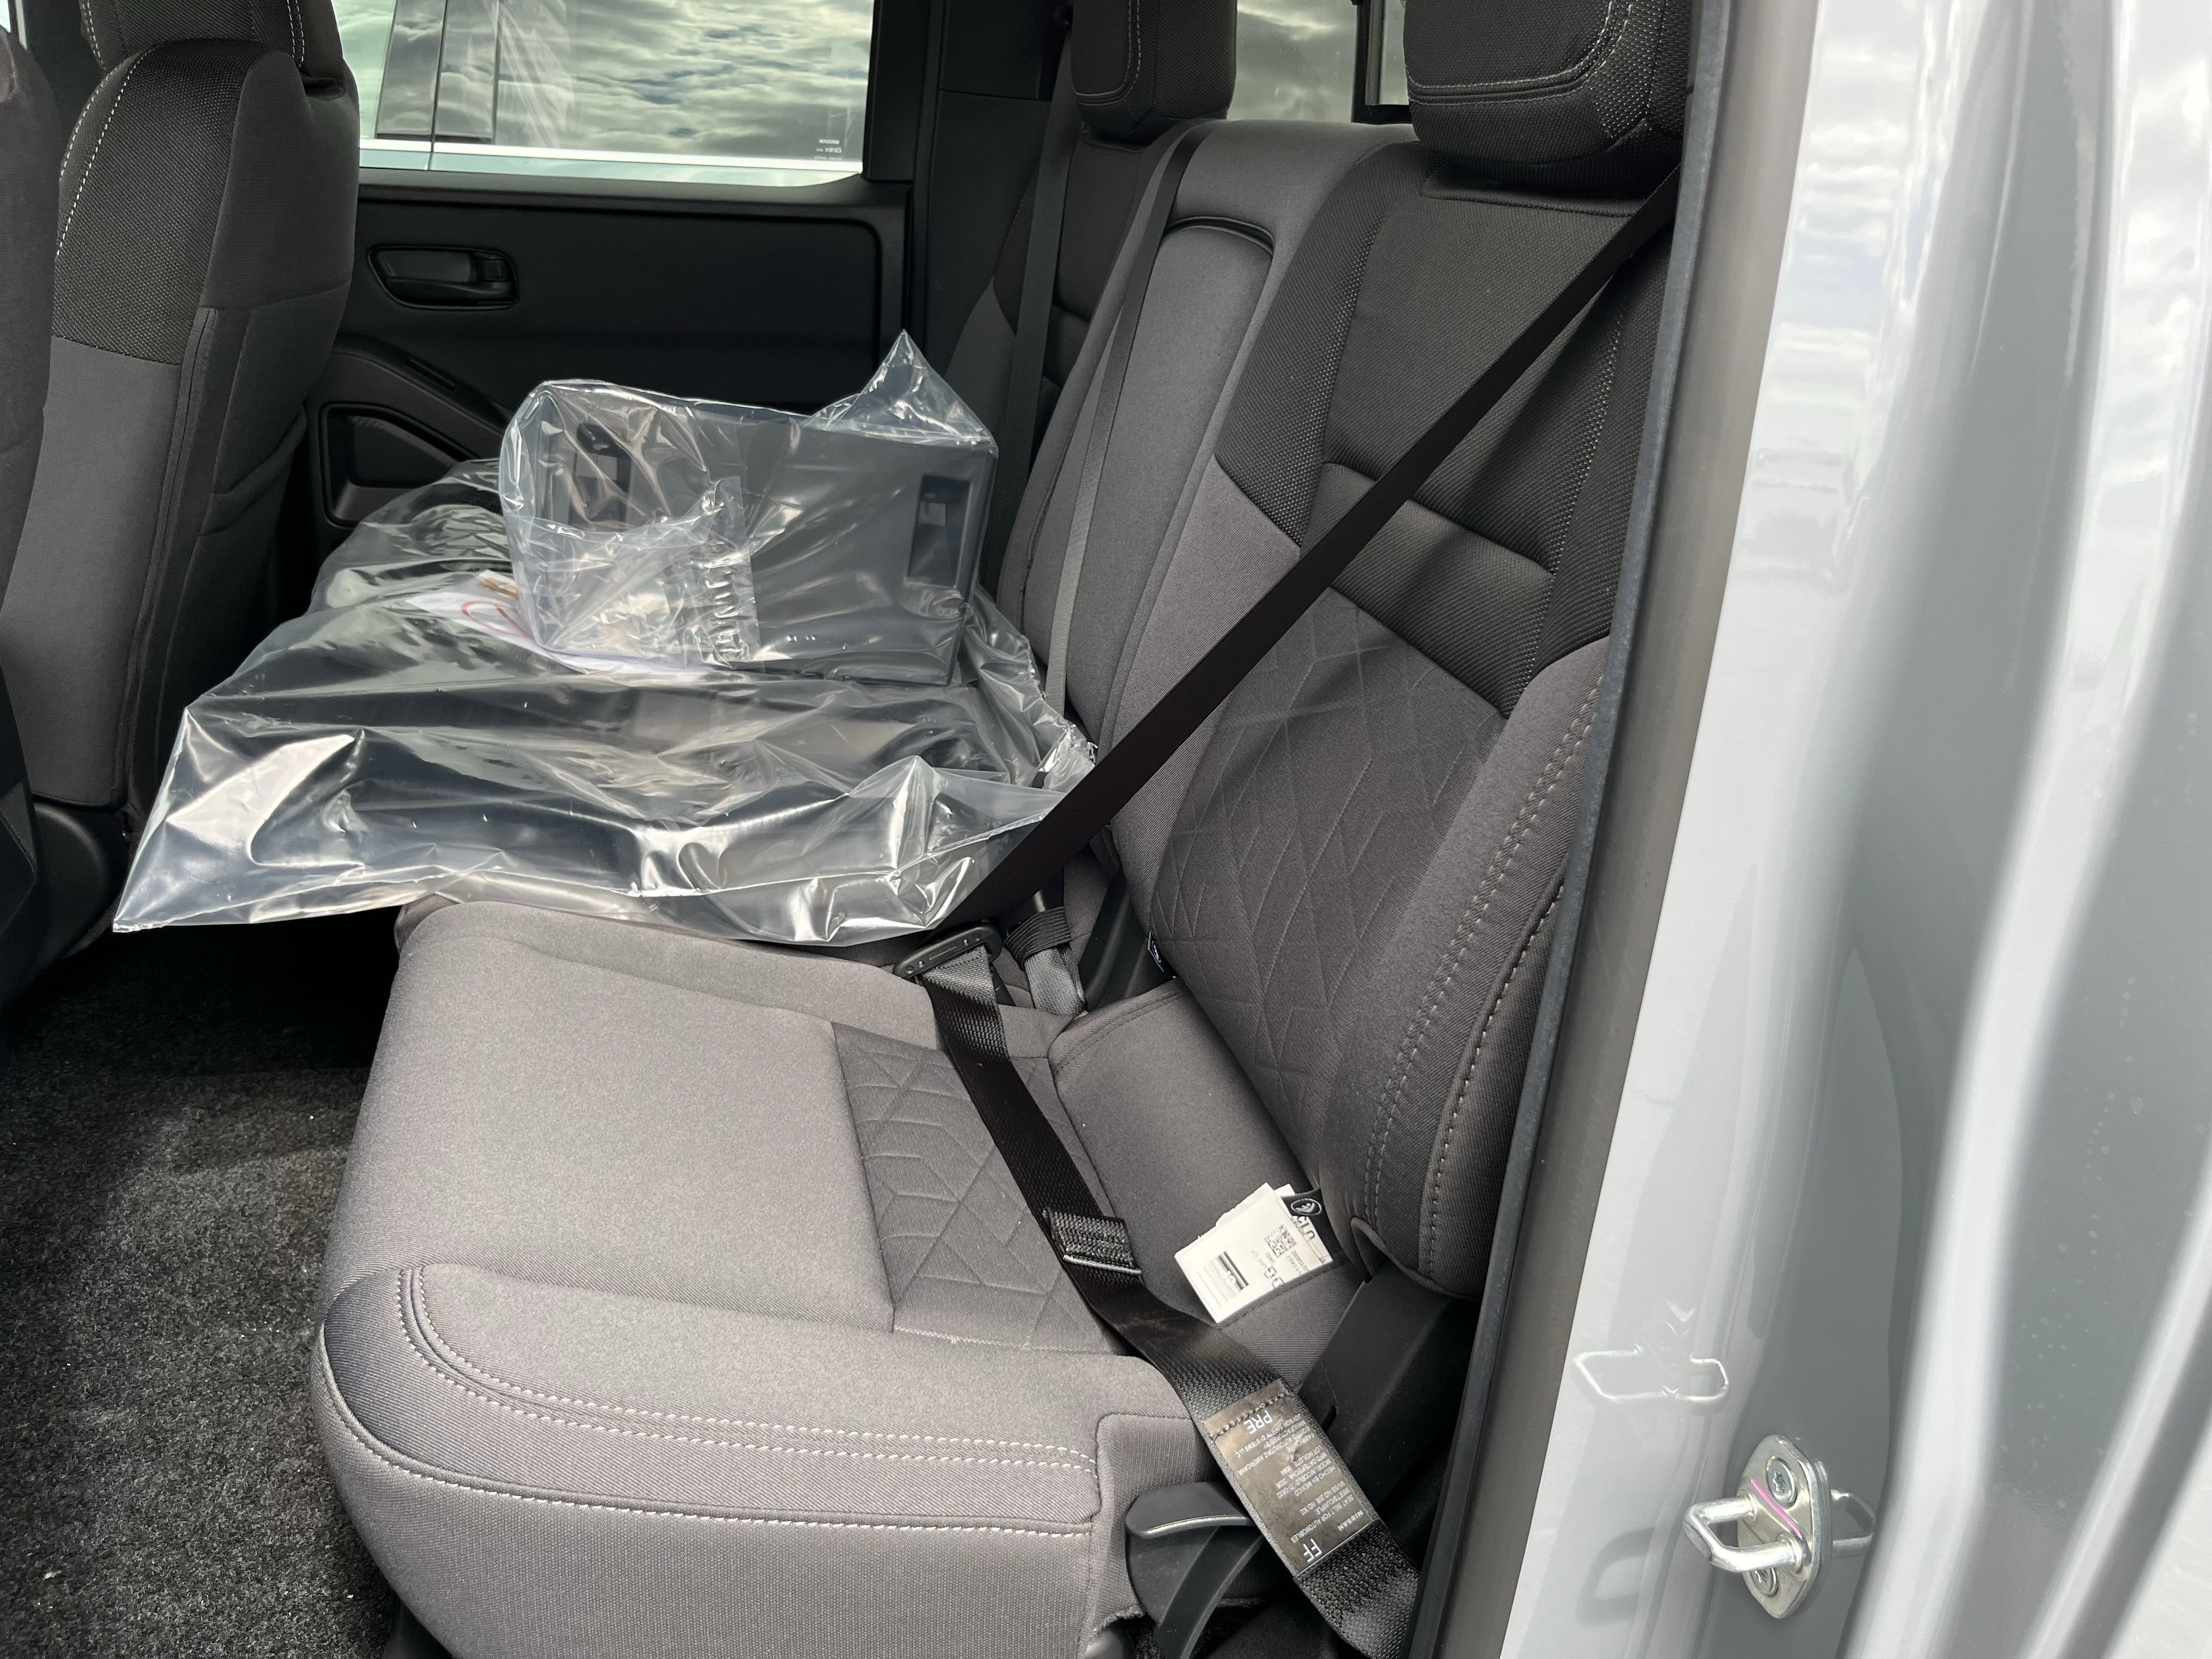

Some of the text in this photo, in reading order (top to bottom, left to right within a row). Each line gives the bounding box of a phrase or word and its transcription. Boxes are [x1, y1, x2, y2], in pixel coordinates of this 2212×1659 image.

[1242, 1409, 1273, 1435] PRE
[1262, 1419, 1306, 1449] MANUFACTURED BY
[1234, 1413, 1302, 1458] JOYSON SAFETY SYSTEMS LLC
[1262, 1436, 1293, 1458] AUTOMOTRIZ
[1312, 1444, 1323, 1454] LOT
[1237, 1454, 1264, 1475] AMERICANA
[1293, 1465, 1336, 1497] HECHO EN MEXICO
[1330, 1480, 1346, 1493] MVSS
[1290, 1494, 1354, 1543] SEAT BELT FOR AUTOMOBILES
[1337, 1510, 1363, 1531] NISSAN
[1302, 1537, 1322, 1562] FF
